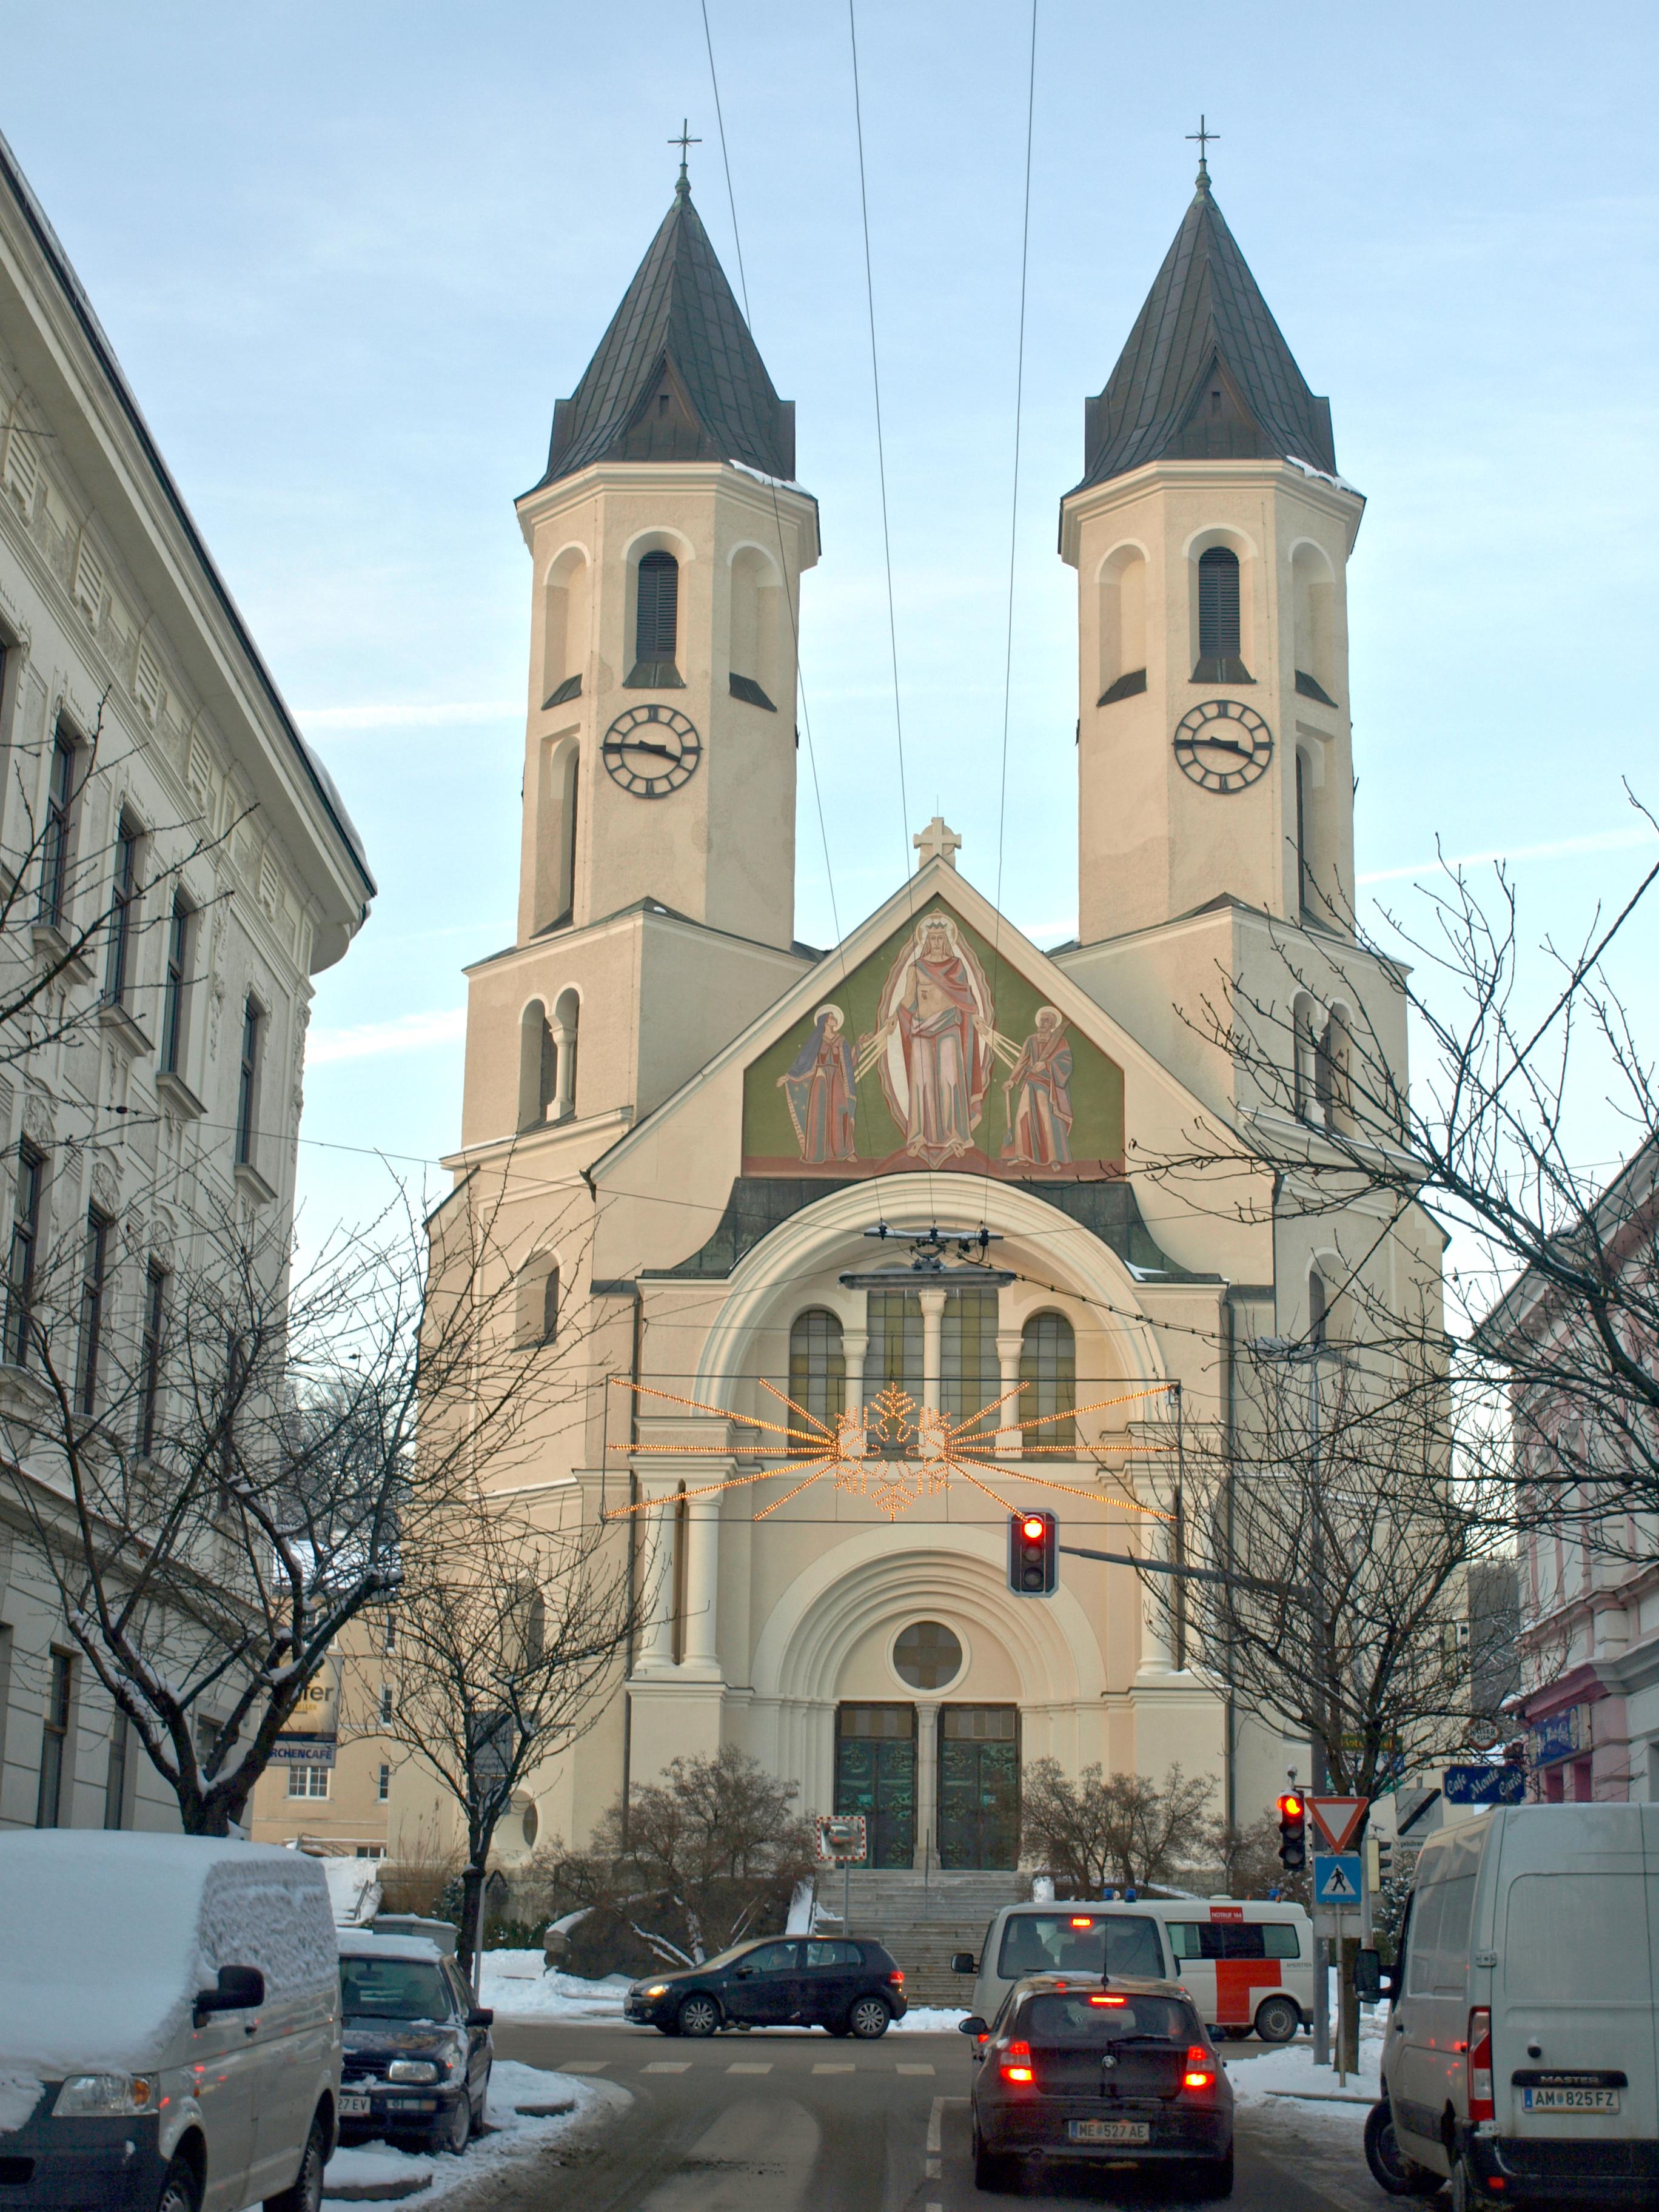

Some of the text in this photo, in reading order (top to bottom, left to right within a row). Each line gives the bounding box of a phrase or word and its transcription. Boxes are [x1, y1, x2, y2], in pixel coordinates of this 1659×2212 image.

[1470, 1769, 1500, 1800] Monte
[1540, 2076, 1599, 2085] MASTER
[1535, 2091, 1555, 2106] AM
[1566, 2091, 1593, 2106] 825
[1595, 2092, 1614, 2106] FZ
[1079, 2124, 1145, 2138] ME 527 AE
